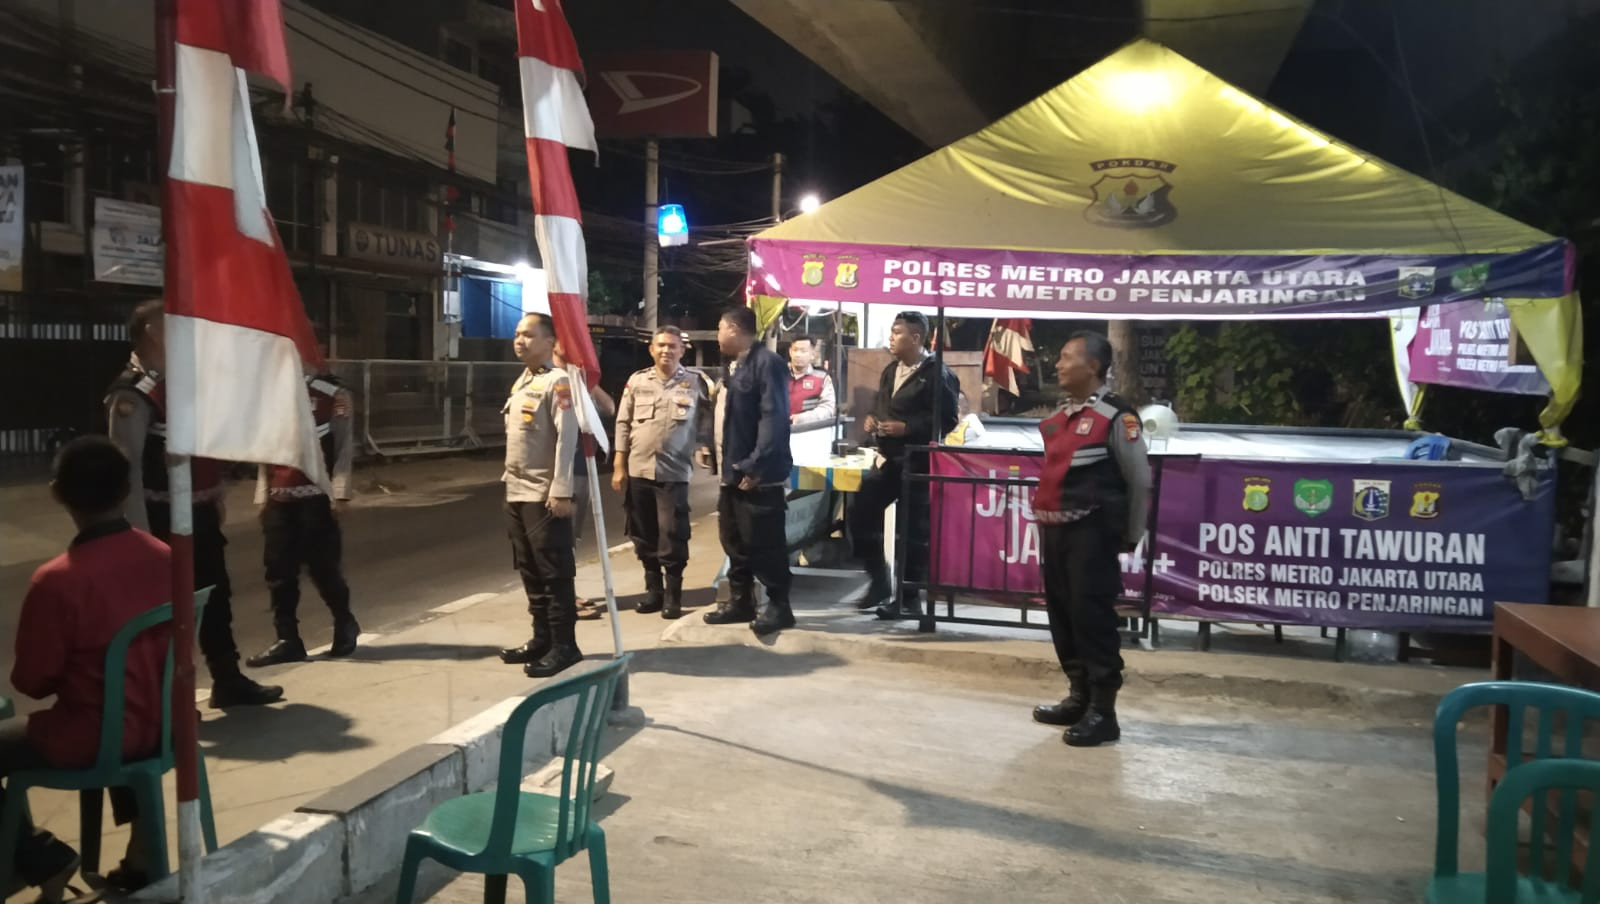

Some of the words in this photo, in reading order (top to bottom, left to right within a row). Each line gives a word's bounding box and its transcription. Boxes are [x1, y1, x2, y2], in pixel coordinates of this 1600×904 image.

[1095, 159, 1170, 170] POKDAR
[372, 232, 437, 261] TUNAS
[884, 259, 991, 279] POLRES
[1001, 265, 1104, 284] METRO
[1113, 269, 1251, 286] JAKARTA
[1262, 269, 1367, 286] UTARA
[882, 277, 997, 298] POLSEK
[1006, 284, 1117, 302] METRO
[1129, 288, 1367, 304] PENJARINGAN
[1199, 522, 1256, 556] POS
[1264, 525, 1330, 558] ANTI
[1340, 528, 1486, 565] TAWURAN
[1198, 560, 1266, 581] POLRES
[1271, 563, 1334, 585] METRO
[1338, 567, 1419, 589] JAKARTA
[1424, 571, 1485, 592] UTARA
[1198, 583, 1270, 605] POLSEK
[1274, 587, 1341, 609] METRO
[1347, 592, 1485, 617] PENJARINGAN
